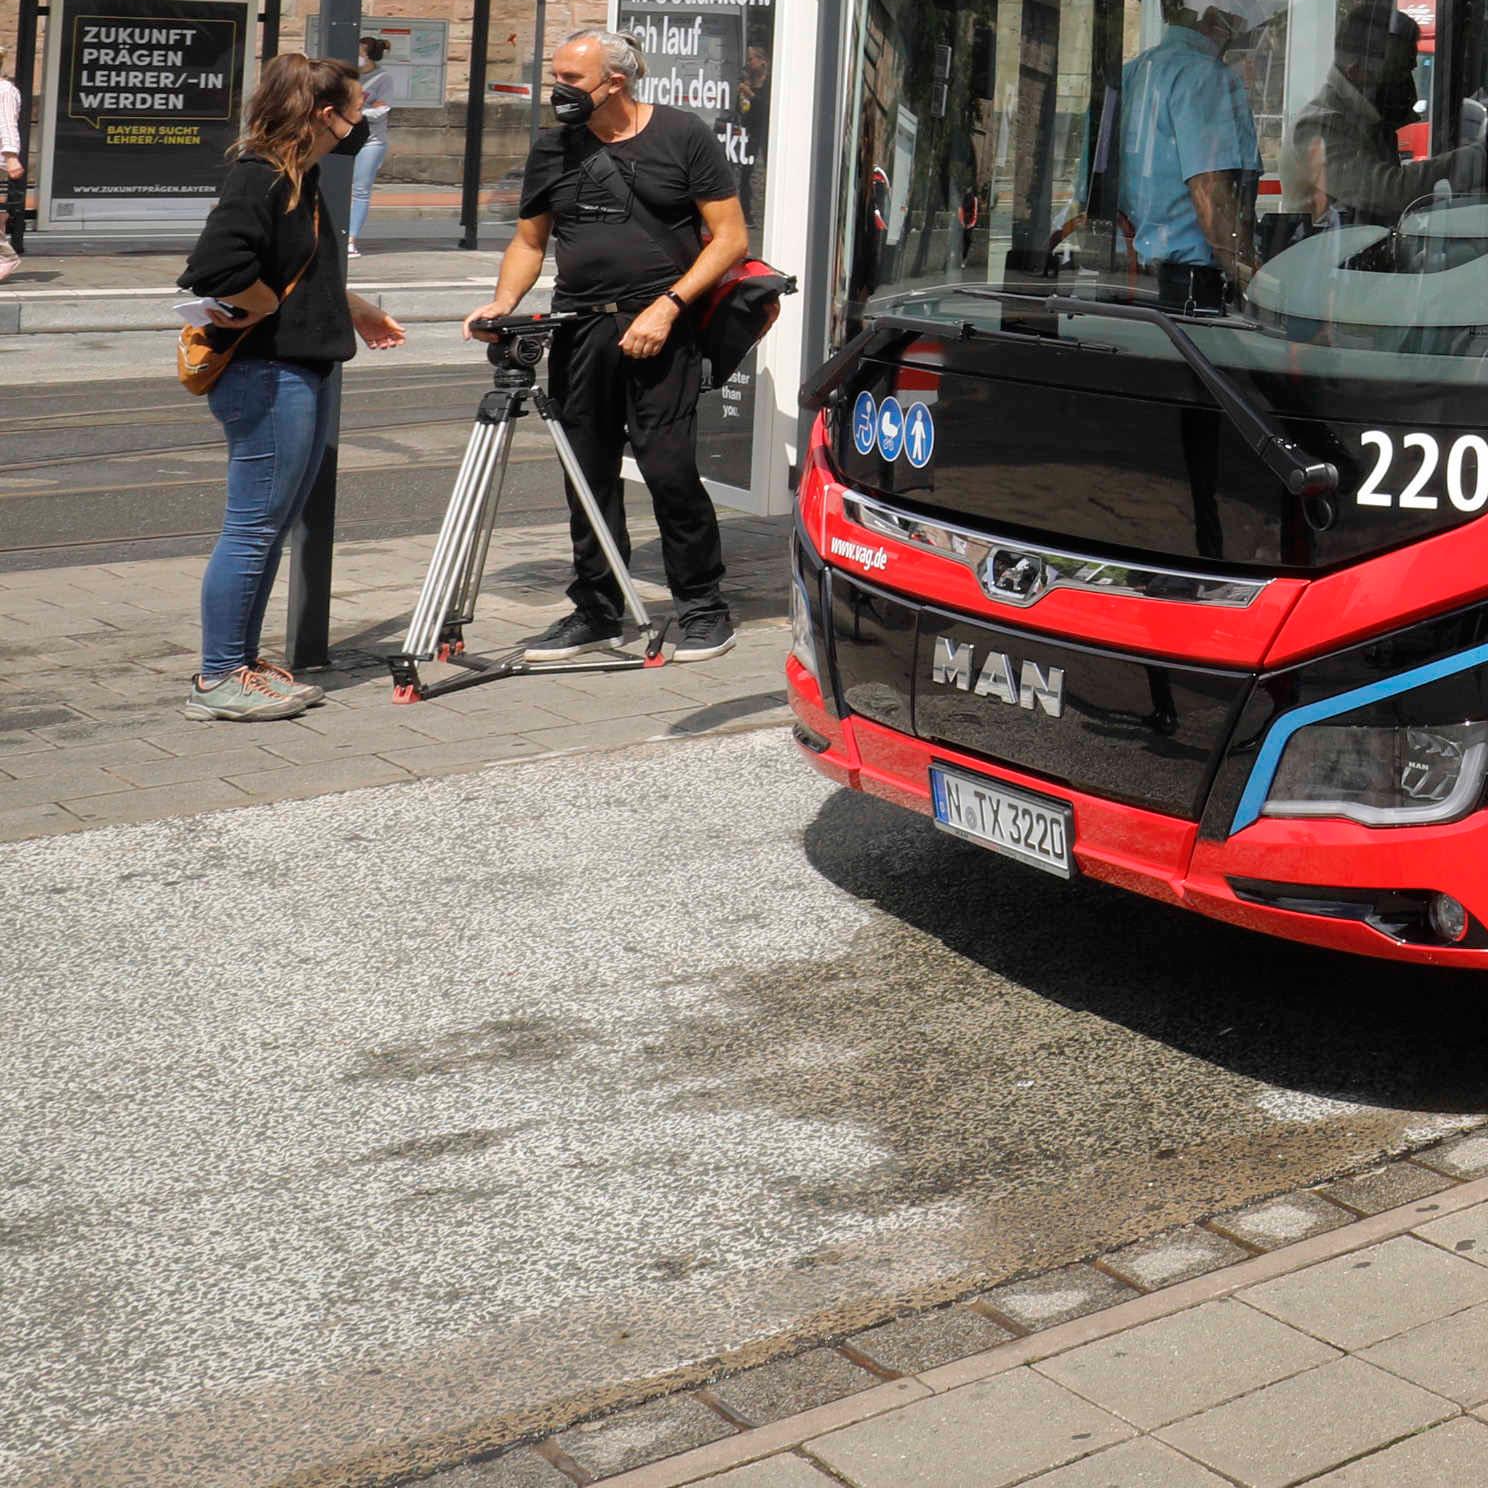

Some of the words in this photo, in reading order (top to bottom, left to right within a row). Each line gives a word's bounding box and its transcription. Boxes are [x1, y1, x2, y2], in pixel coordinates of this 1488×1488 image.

[82, 26, 197, 46] ZUKUNFT
[662, 15, 702, 56] lauf
[81, 45, 184, 67] PRÄGEN
[80, 70, 224, 89] LEHRER/-IN
[688, 68, 731, 110] den
[79, 92, 185, 110] WERDEN
[106, 126, 156, 135] BAYERN
[158, 126, 201, 135] SUCHT
[106, 135, 201, 145] LEHRER/-INNEN
[721, 385, 742, 401] than
[831, 536, 888, 571] www.vag.de
[932, 635, 1065, 719] MAN
[946, 779, 962, 823] N
[974, 790, 1005, 840] TX
[1007, 802, 1065, 860] 3220
